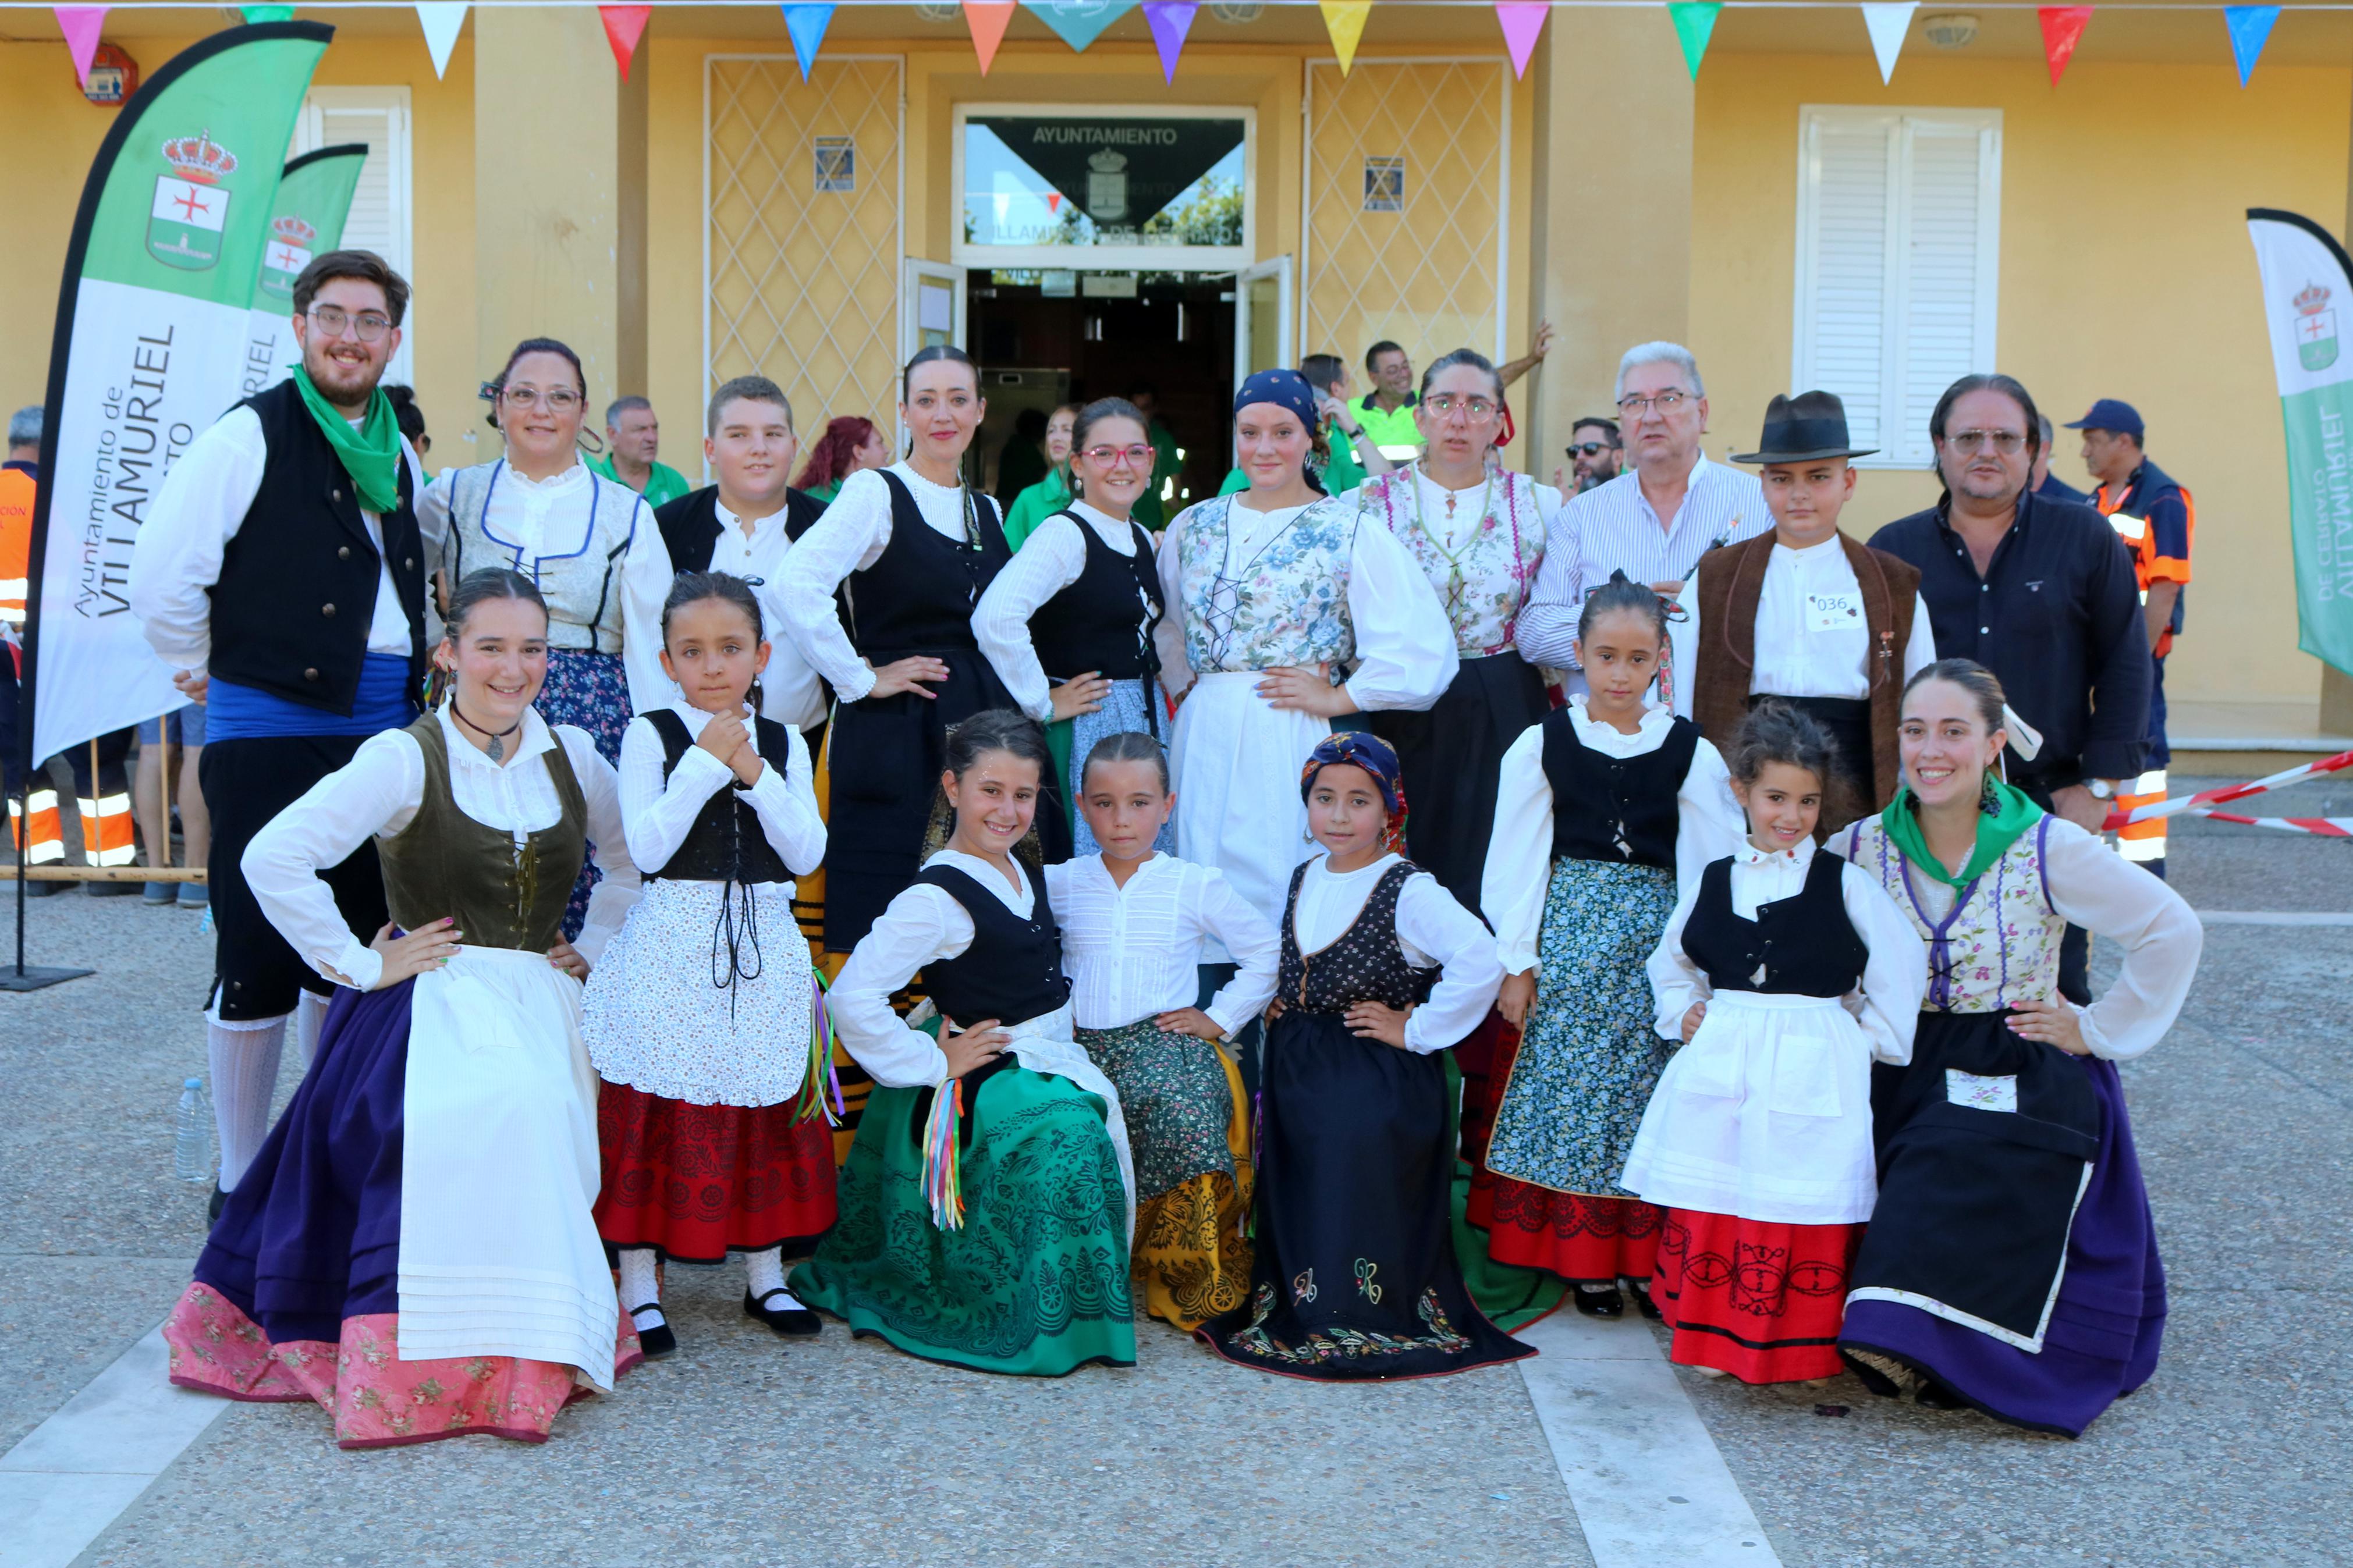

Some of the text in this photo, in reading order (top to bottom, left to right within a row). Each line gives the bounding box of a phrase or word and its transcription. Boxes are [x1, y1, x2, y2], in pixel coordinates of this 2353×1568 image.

[1033, 126, 1177, 145] AYUNTAMIENTO
[74, 386, 123, 618] Ayuntamiento de
[1818, 597, 1847, 611] 036
